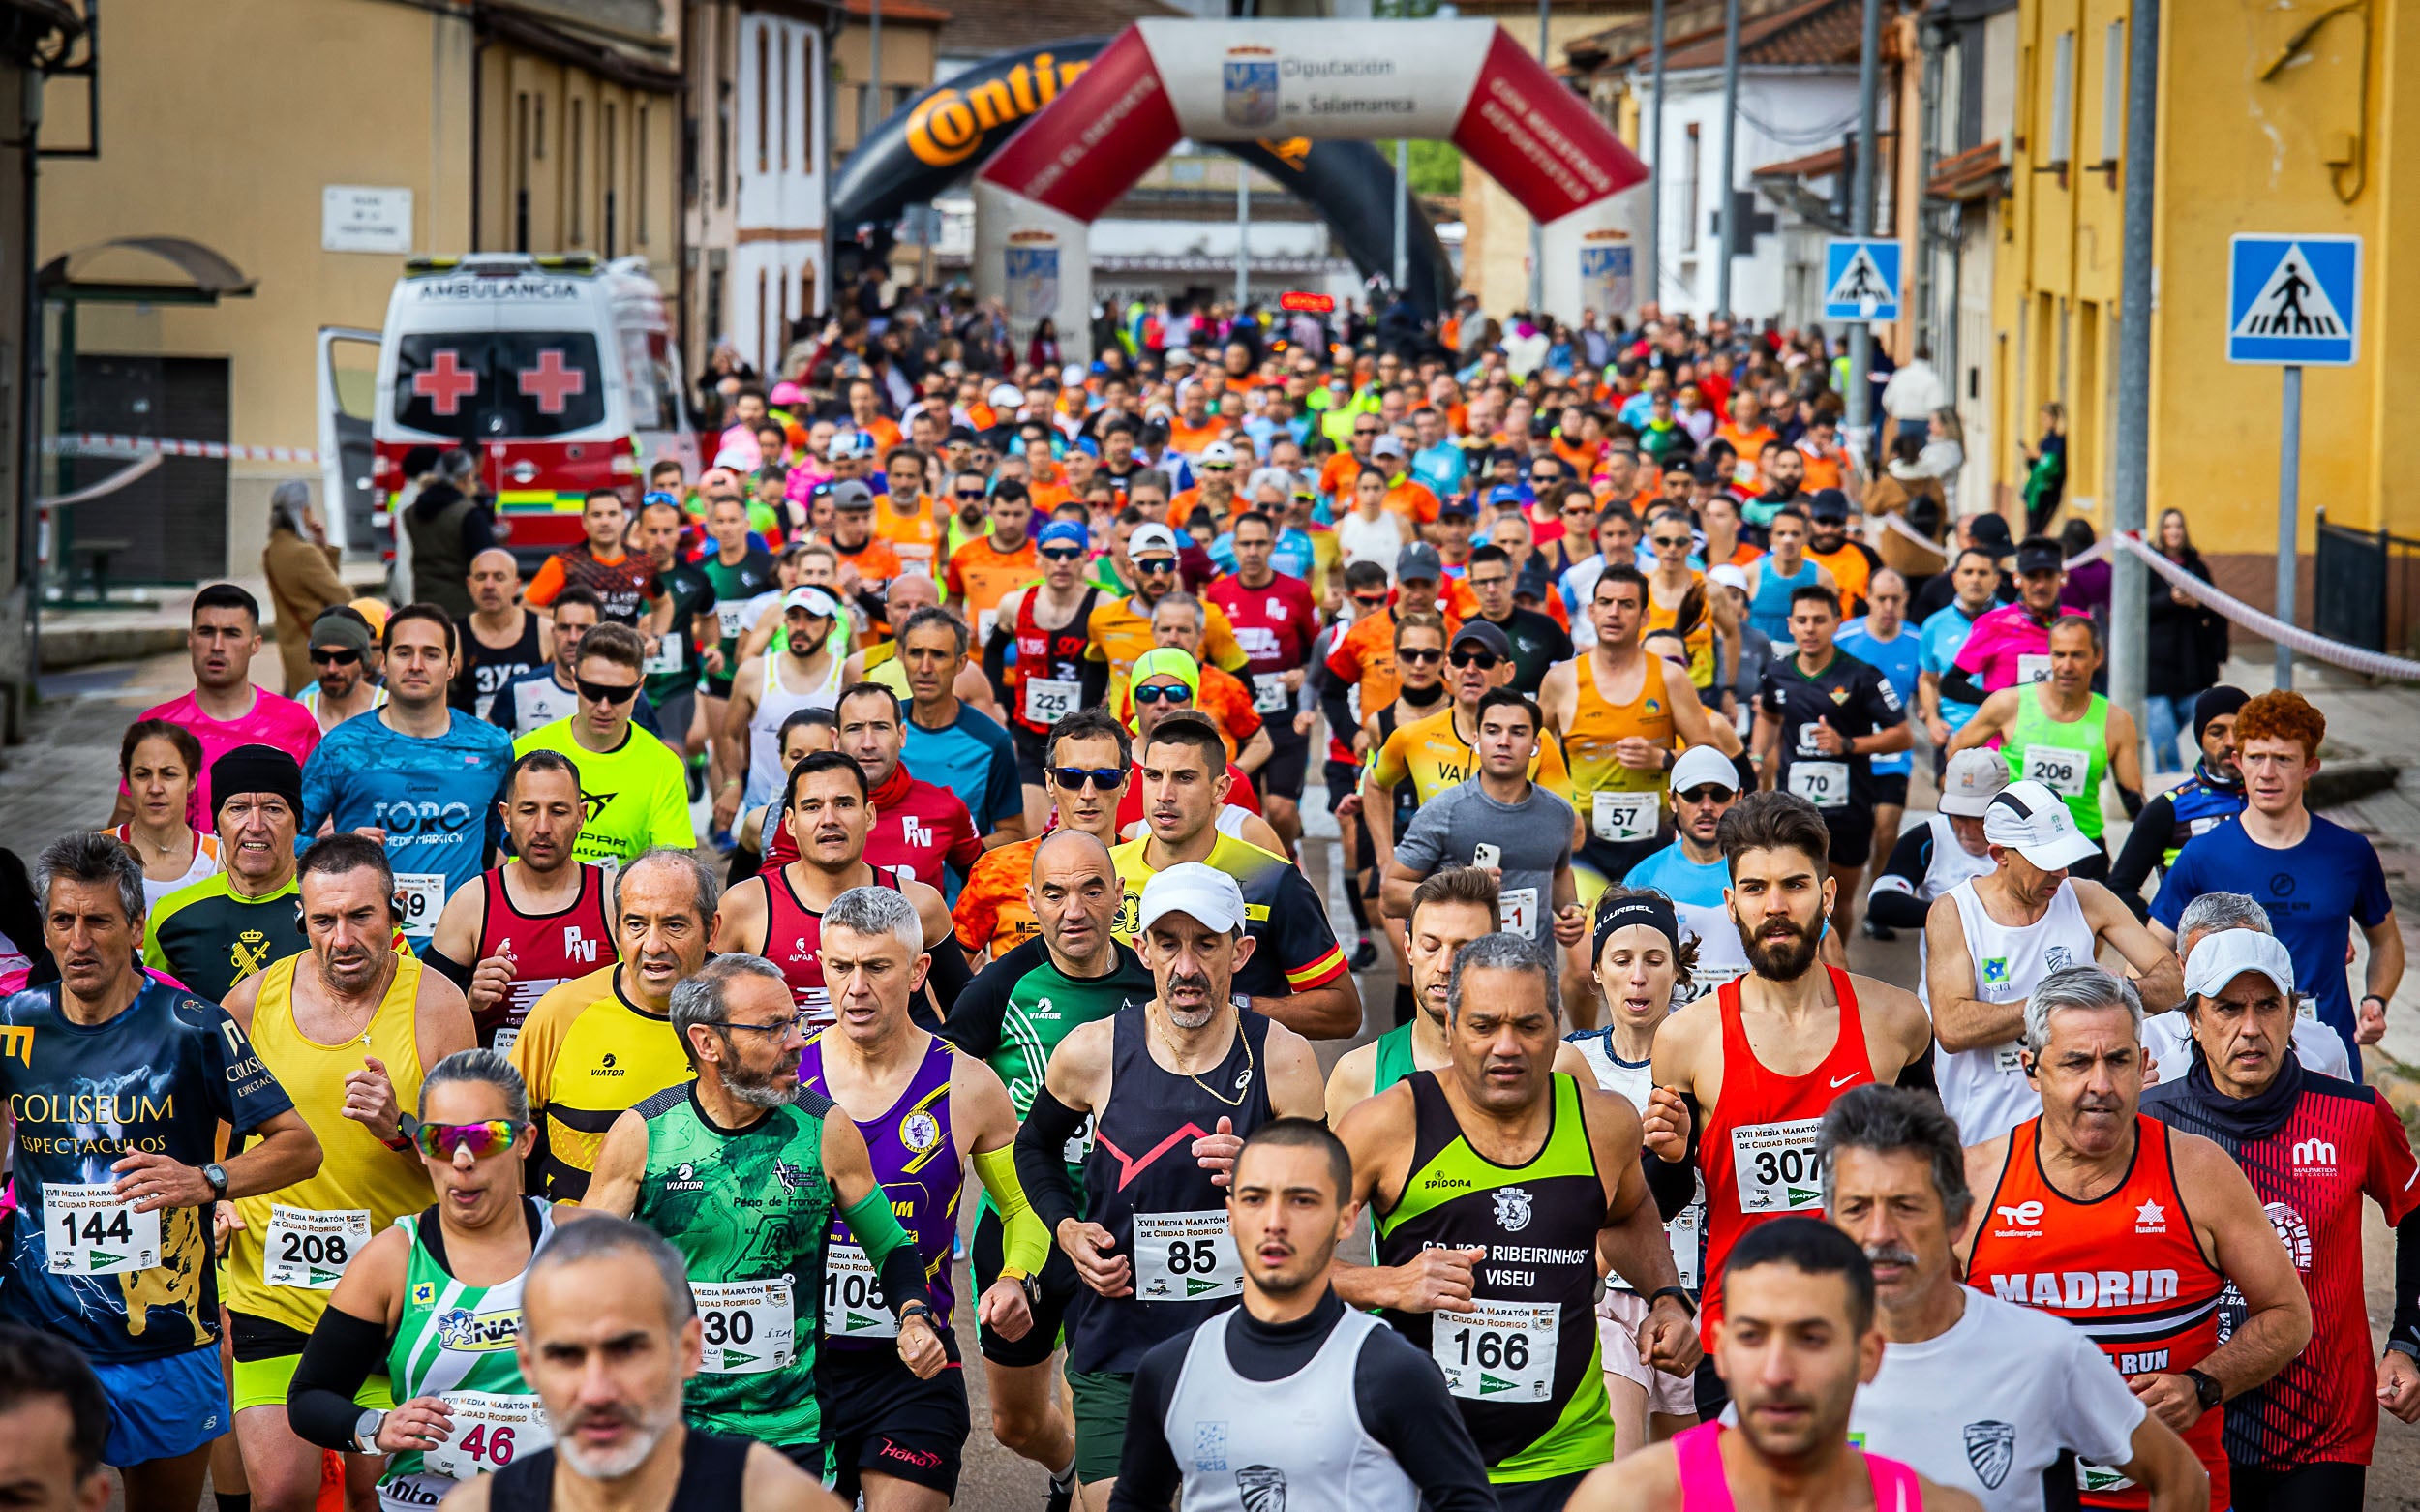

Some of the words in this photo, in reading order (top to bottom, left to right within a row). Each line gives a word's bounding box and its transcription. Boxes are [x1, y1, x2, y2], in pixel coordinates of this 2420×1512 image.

[1309, 94, 1417, 114] Salamanca
[418, 283, 580, 299] AMBULANCIA
[1036, 694, 1067, 711] 225
[1805, 775, 1828, 792] 70
[374, 801, 471, 833] TORO
[1612, 808, 1638, 826] 57
[409, 893, 425, 917] 9
[1603, 905, 1654, 923] LURBEL
[590, 1069, 625, 1077] VIATOR
[11, 1093, 174, 1124] COLISEUM
[1736, 1130, 1753, 1139] XVII
[1755, 1129, 1780, 1138] MEDIA
[22, 1134, 166, 1155] ESPECTACULOS
[1739, 1141, 1750, 1150] DE
[1752, 1139, 1783, 1149] CIUDAD
[1754, 1147, 1820, 1186] 307
[666, 1180, 704, 1190] VIATOR
[1424, 1179, 1471, 1189] SPIDORA
[61, 1189, 85, 1197] MEDIA
[87, 1189, 112, 1197] MARA
[58, 1199, 87, 1208] CIUDAD
[286, 1211, 306, 1222] MEDIA
[309, 1214, 345, 1224] MARATÓN
[1137, 1219, 1156, 1227] XVII
[1157, 1219, 1183, 1227] MEDIA
[1185, 1216, 1225, 1226] MARATÓN
[62, 1210, 132, 1246] 144
[282, 1221, 307, 1230] CIUDAD
[308, 1225, 342, 1233] RODRIGO
[1154, 1229, 1184, 1238] CIUDAD
[1187, 1228, 1223, 1237] RODRIGO
[1994, 1229, 2043, 1239] TotalEnergies
[2135, 1225, 2166, 1234] luanvi
[282, 1232, 348, 1265] 208
[1167, 1239, 1217, 1275] 85
[828, 1262, 851, 1271] IUDAD
[1485, 1269, 1535, 1286] VISEU
[694, 1287, 720, 1297] MEDIA
[722, 1286, 763, 1296] MARATÓN
[825, 1272, 884, 1309] 105
[1990, 1269, 2179, 1309] MADRID
[696, 1299, 721, 1308] IUDAD
[723, 1298, 761, 1307] RODRIGO
[1487, 1307, 1530, 1317] MARATÓN
[1439, 1313, 1450, 1321] DE
[1452, 1315, 1485, 1325] CIUDAD
[1487, 1318, 1528, 1329] RODRIGO
[1454, 1327, 1528, 1371] 166
[2121, 1349, 2170, 1374] RUN
[460, 1398, 486, 1407] MEDIA
[490, 1401, 530, 1410] MARATÓN
[488, 1412, 528, 1423] RODRIGO
[459, 1424, 515, 1466] 46
